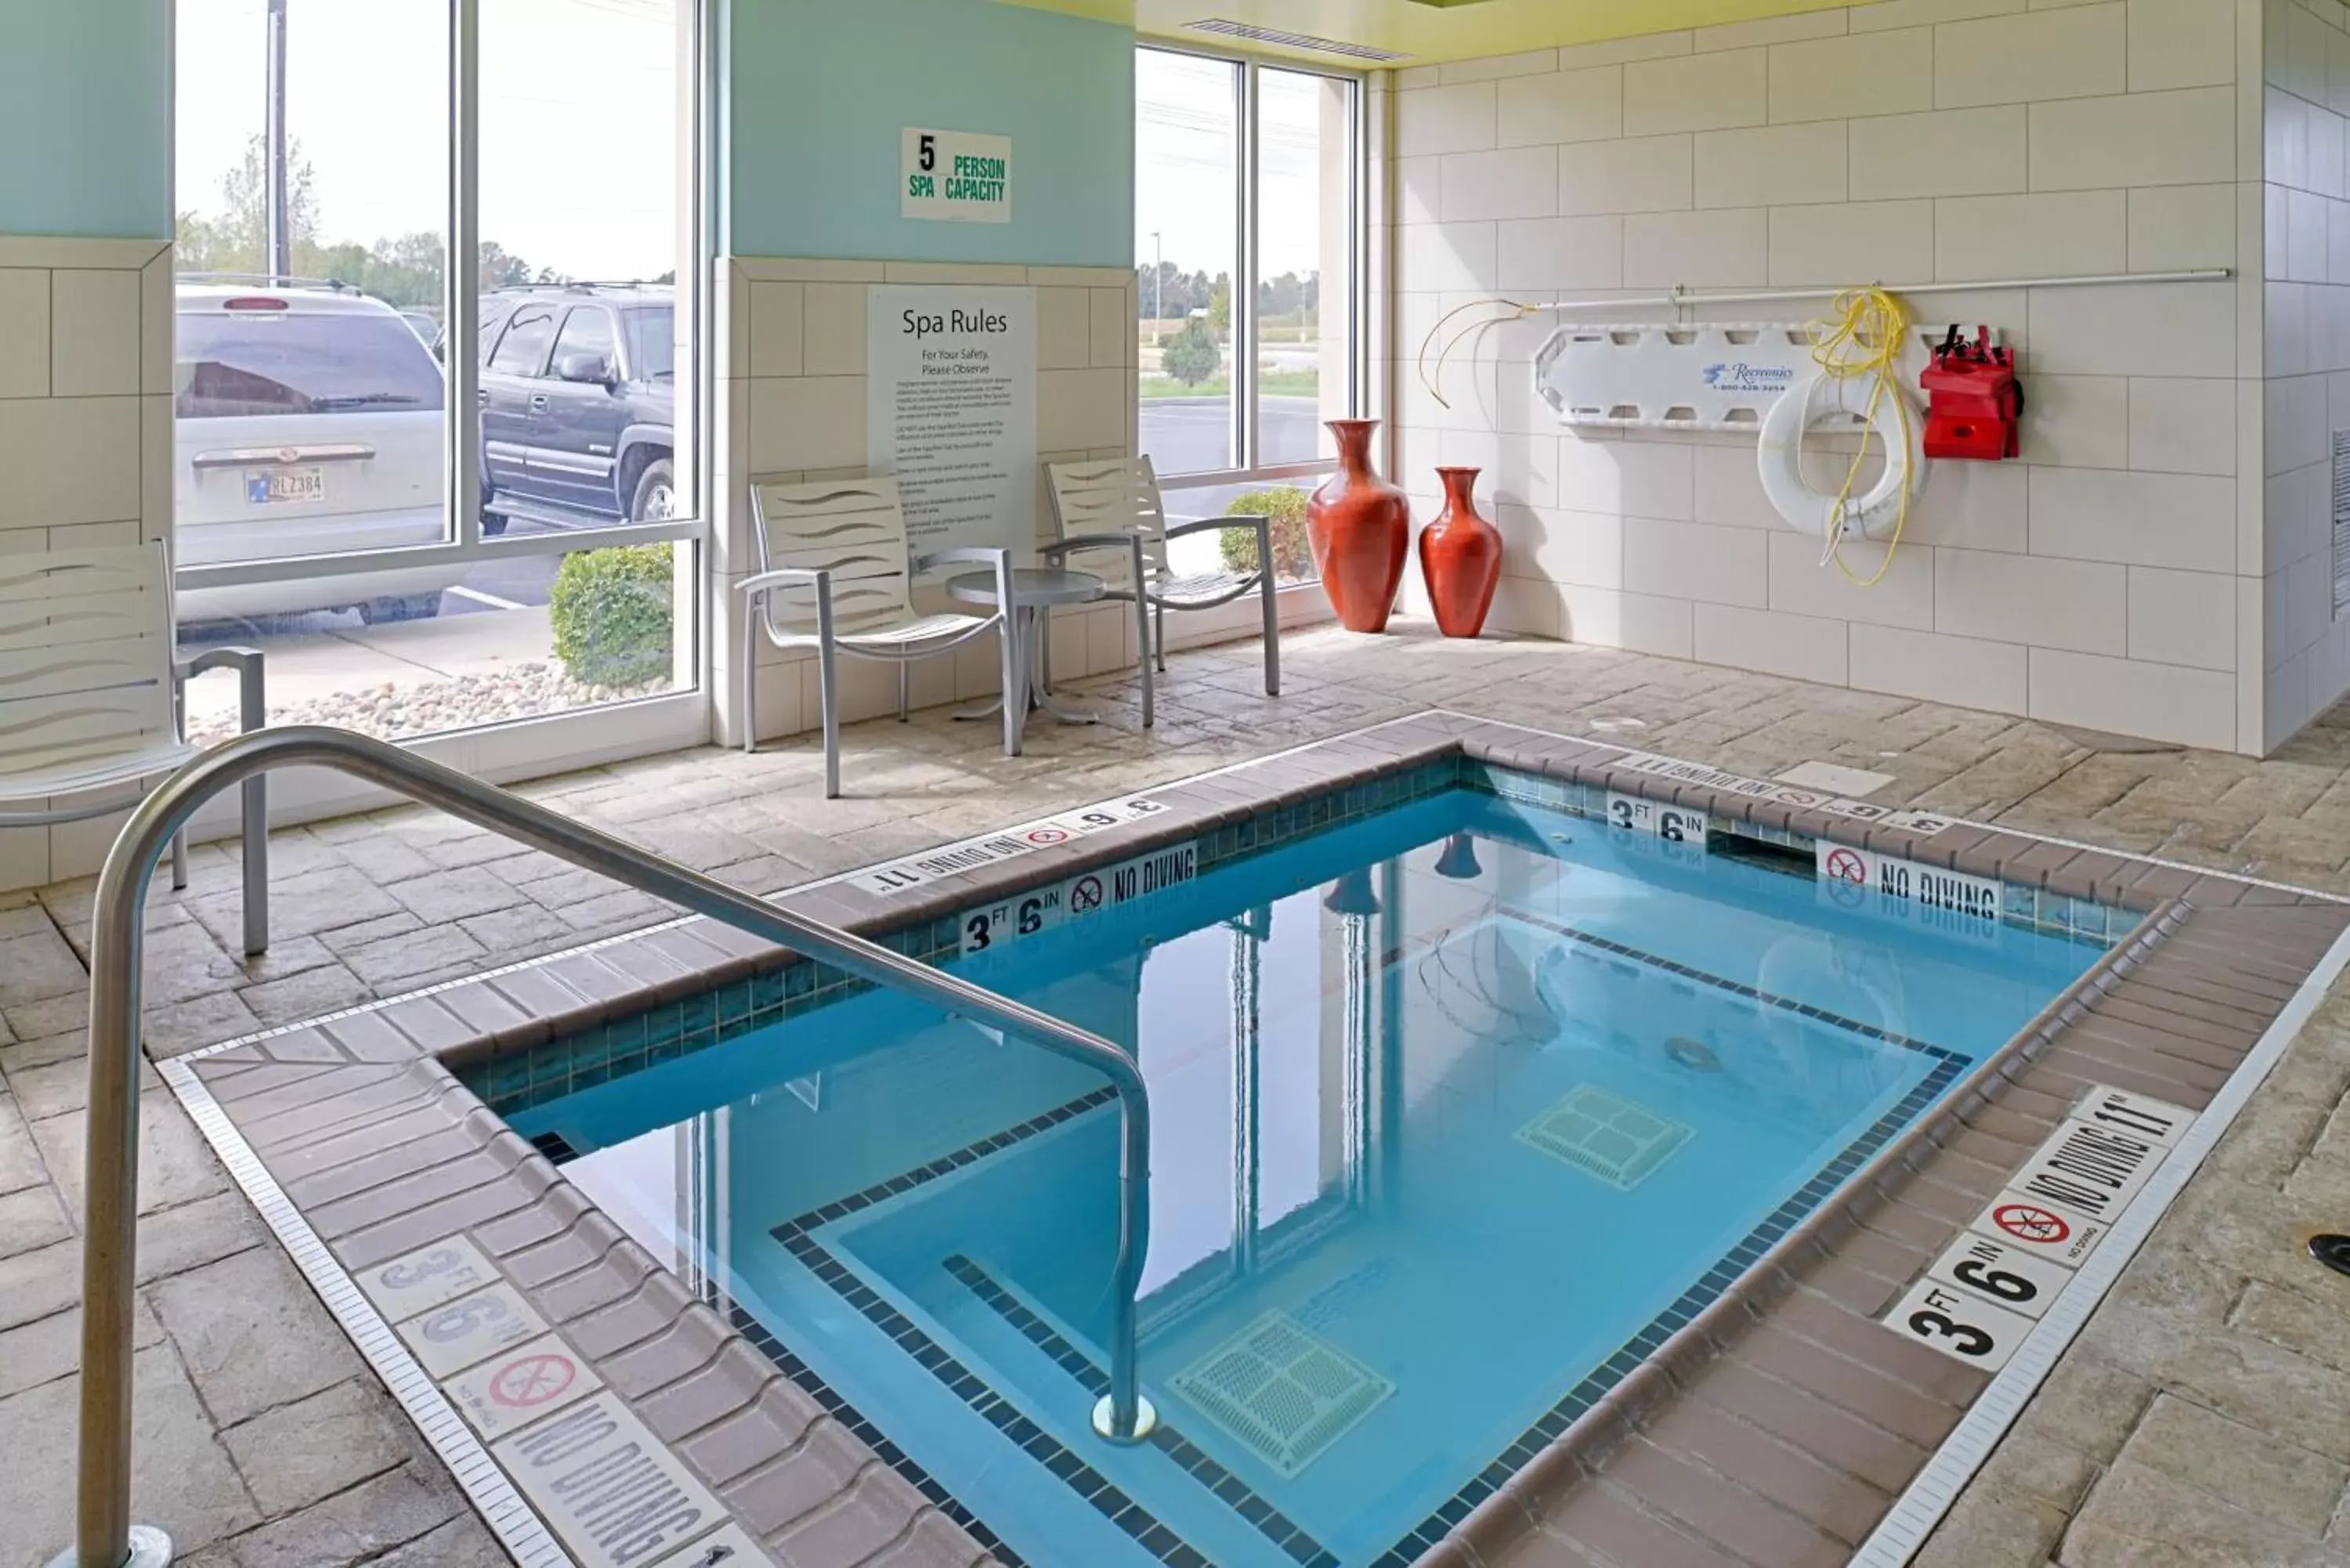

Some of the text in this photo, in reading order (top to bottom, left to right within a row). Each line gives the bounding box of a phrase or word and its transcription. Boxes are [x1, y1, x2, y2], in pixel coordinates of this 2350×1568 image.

[920, 135, 1005, 179] 5 PERSON
[909, 175, 1005, 202] SPA CAPACITY
[903, 308, 1007, 339] Spa Rules
[922, 349, 938, 360] For
[938, 349, 959, 359] Your
[922, 363, 990, 375] Please Observe
[1671, 767, 1738, 787] DIVING
[1081, 813, 1118, 825] 6
[916, 847, 995, 873] DIVING
[984, 837, 1025, 854] NO
[1612, 800, 1994, 920] 3 FT 6 IN NO DIVING
[967, 847, 1194, 953] 3 FT 6 IN NO DIVING
[2047, 1127, 2150, 1190] DIVING
[2025, 1173, 2110, 1215] NO
[1968, 1240, 2004, 1263] IN
[2067, 1227, 2098, 1259] NO DIVING
[380, 1249, 461, 1289] 3
[1953, 1259, 2037, 1302] 6
[1924, 1288, 1960, 1313] FT
[423, 1295, 508, 1343] 6
[1908, 1310, 1994, 1357] 3
[513, 1402, 618, 1467] NO
[548, 1441, 703, 1566] DIVING
